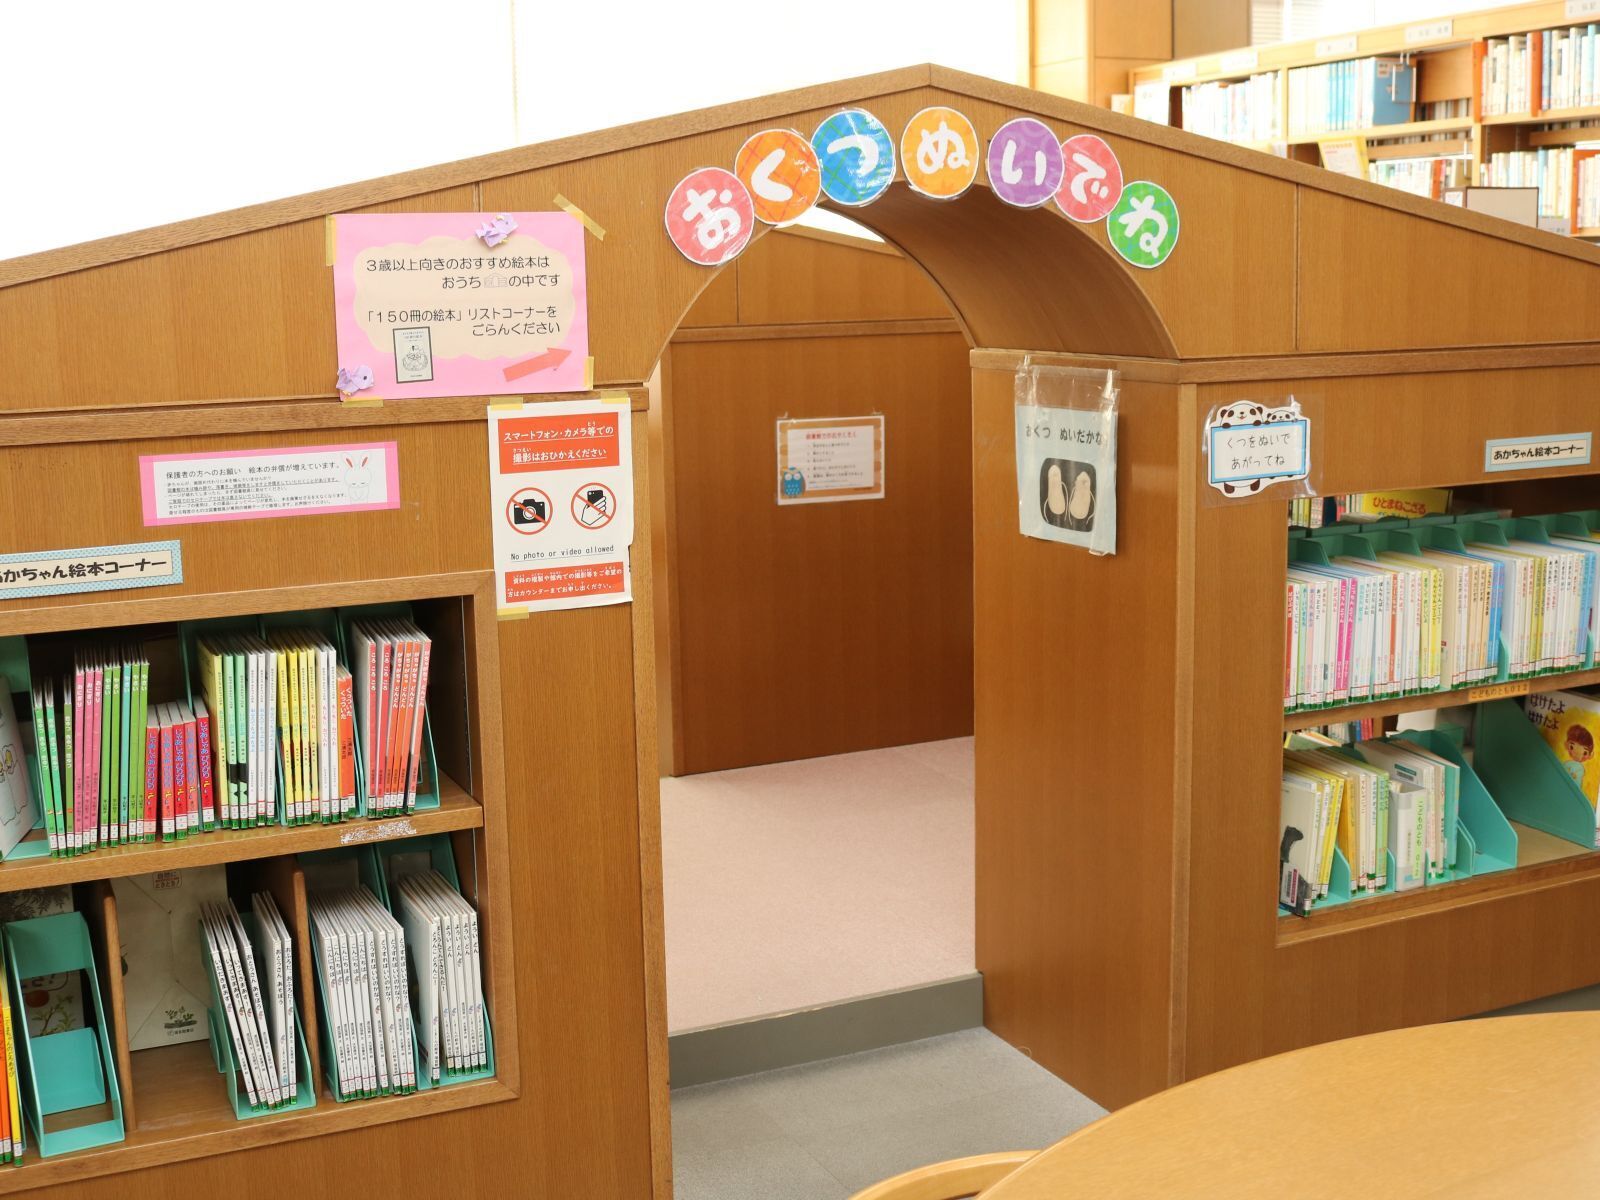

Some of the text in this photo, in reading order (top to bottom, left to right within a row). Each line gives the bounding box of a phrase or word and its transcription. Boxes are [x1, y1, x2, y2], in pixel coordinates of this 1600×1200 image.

[366, 256, 549, 272] ３歳以上向きのおすすめ絵本は
[442, 273, 560, 289] おうち の中です
[472, 322, 560, 337] ごらんください
[504, 426, 614, 441] スマートフォン・カメラ等での
[1227, 433, 1290, 449] くつをぬいで
[513, 448, 606, 463] 撮影はおひかえください
[1494, 444, 1584, 460] あかちゃん絵本コーナー
[1231, 453, 1285, 470] あがってね
[166, 462, 339, 479] 保護者の方へのお願い 絵本の弁償が増えています。
[1373, 496, 1426, 515] ひとまねこざる
[511, 552, 520, 561] No
[523, 550, 545, 560] photo
[561, 548, 582, 557] video
[585, 544, 614, 554] allowed
[0, 558, 166, 583] かちゃん絵本コーナー
[1530, 693, 1566, 715] はけたよ
[1527, 709, 1560, 730] はけたよ
[326, 946, 336, 977] こんにちは
[333, 944, 342, 976] こんにちは
[341, 942, 349, 974] こんにちは
[351, 943, 360, 974] こんにちは
[359, 941, 367, 972] こんにちは
